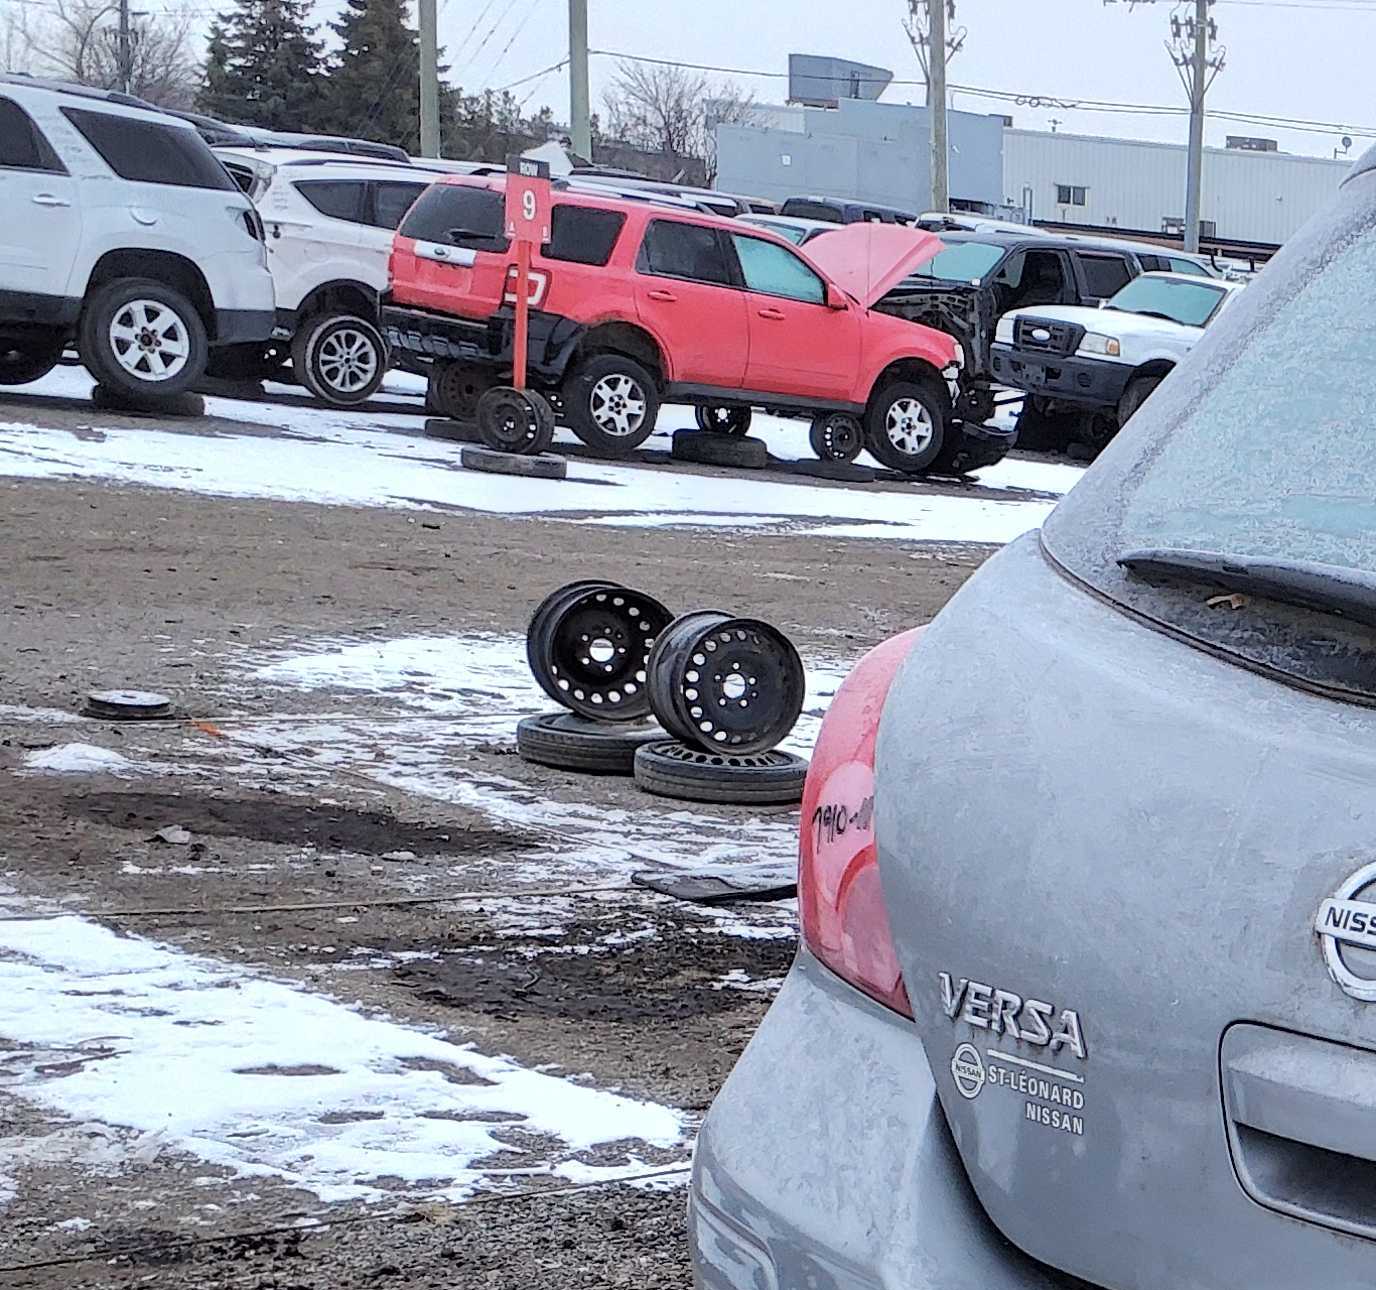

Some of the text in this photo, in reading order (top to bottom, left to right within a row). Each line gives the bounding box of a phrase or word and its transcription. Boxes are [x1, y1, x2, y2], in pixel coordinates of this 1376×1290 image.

[523, 189, 536, 220] 9
[938, 971, 1088, 1059] VERSA
[955, 1061, 982, 1079] NISSAN
[988, 1065, 1085, 1110] ST-LÉONARD
[1026, 1102, 1083, 1135] NISSAN
